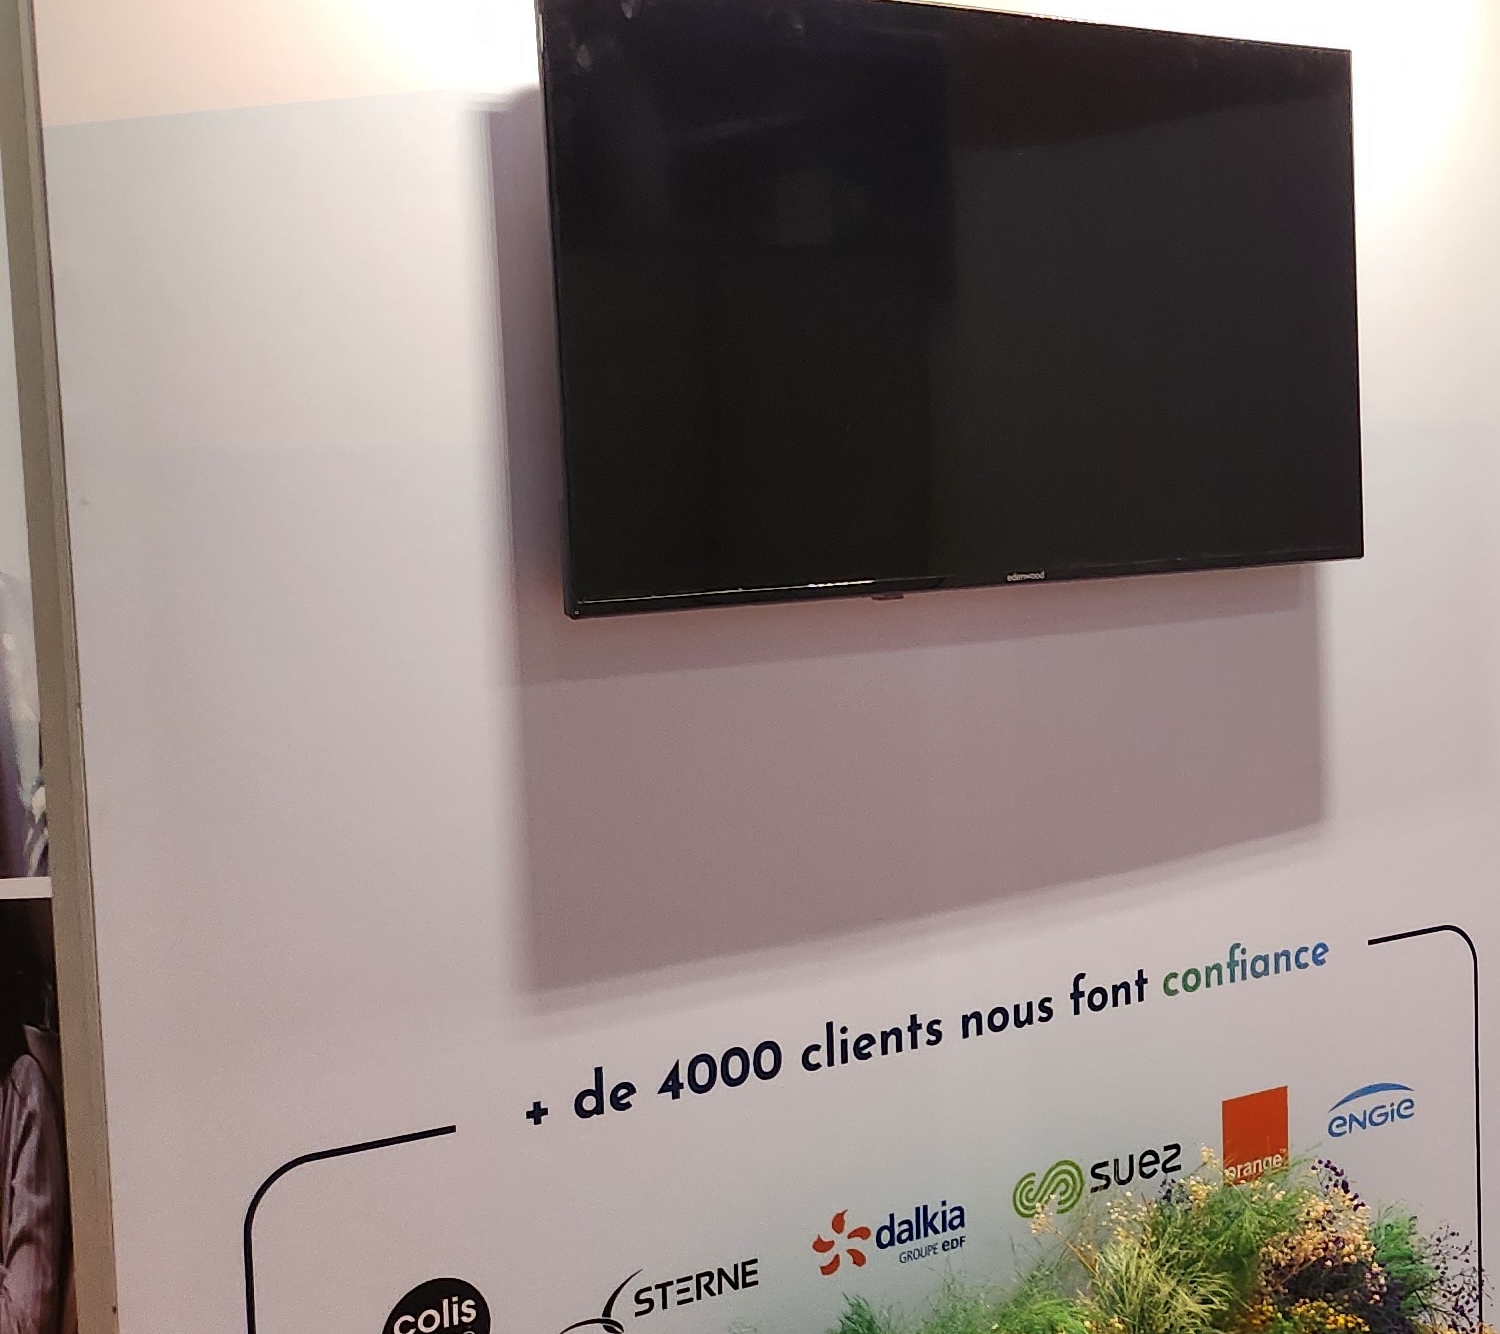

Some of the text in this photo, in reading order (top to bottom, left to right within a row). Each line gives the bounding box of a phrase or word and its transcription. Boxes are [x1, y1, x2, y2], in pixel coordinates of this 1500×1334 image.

[525, 941, 1330, 1125] + de 4000 clients nous font confiance
[1089, 1143, 1182, 1193] suez
[1223, 1153, 1283, 1181] orange
[876, 1200, 965, 1249] dalkia
[899, 1242, 939, 1264] GROUPE
[634, 1258, 759, 1317] STERNE
